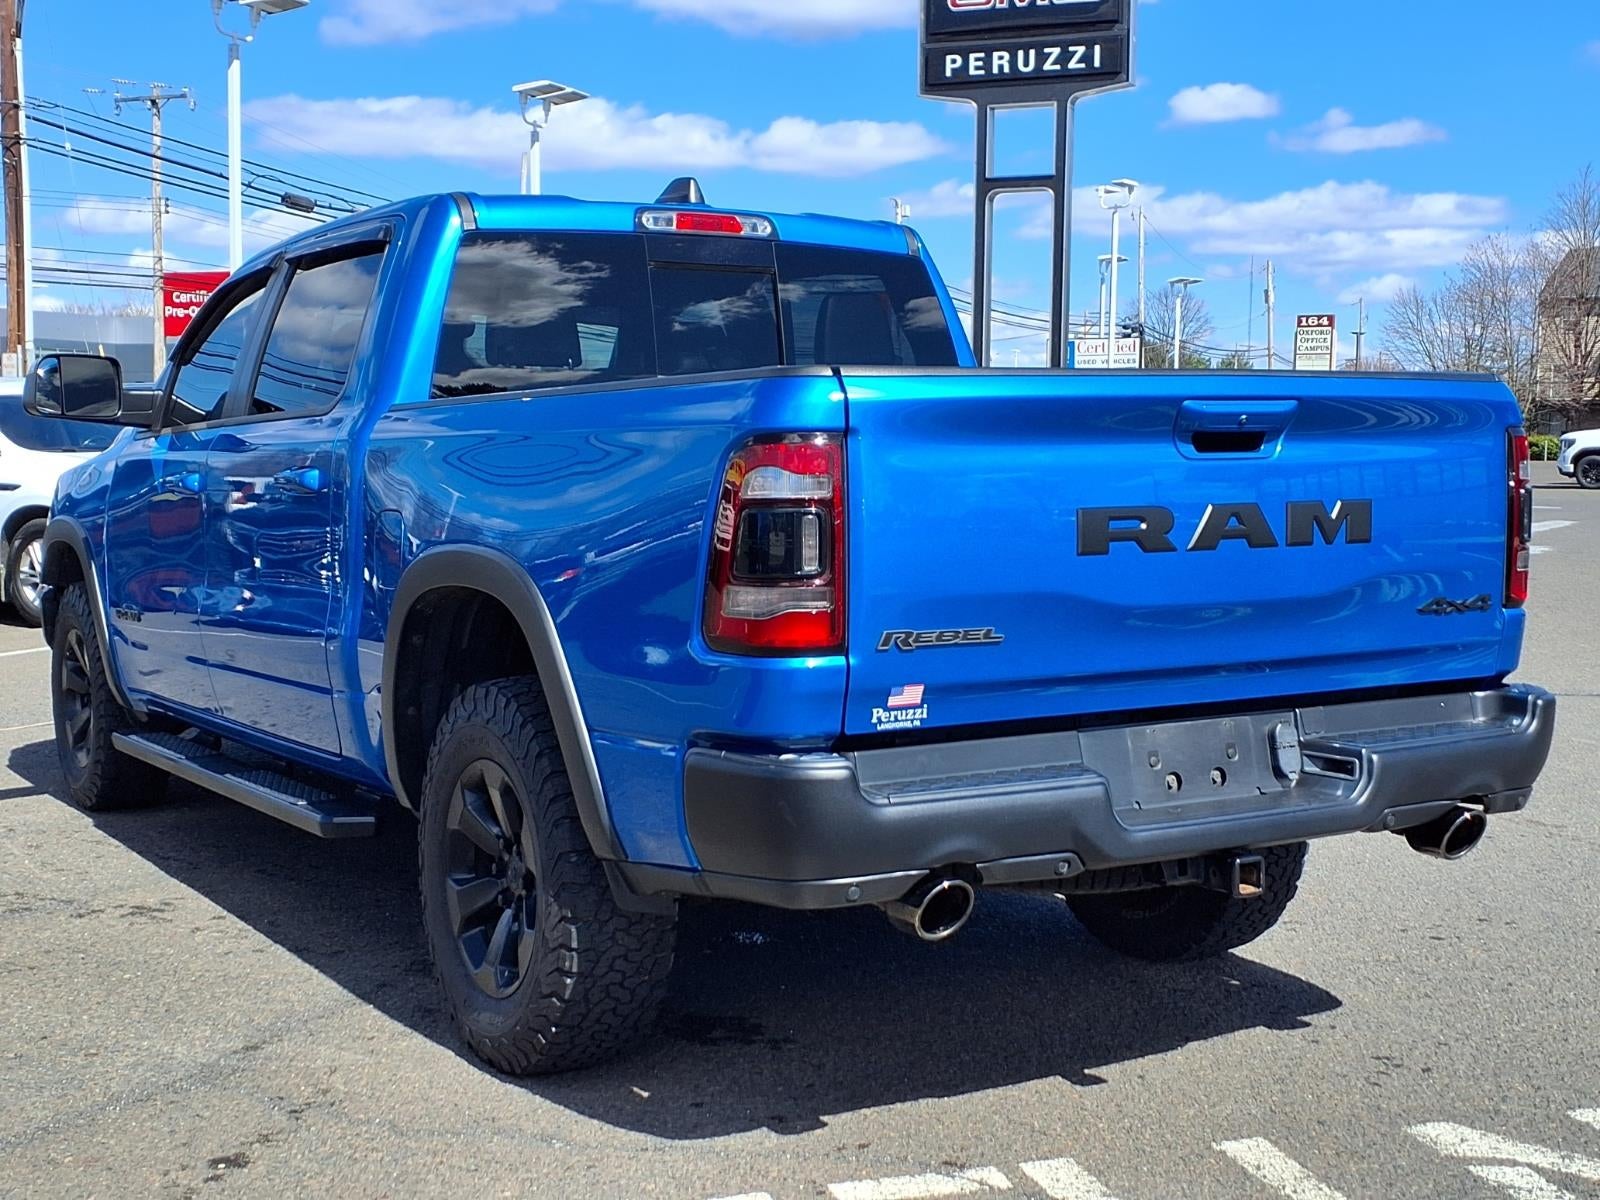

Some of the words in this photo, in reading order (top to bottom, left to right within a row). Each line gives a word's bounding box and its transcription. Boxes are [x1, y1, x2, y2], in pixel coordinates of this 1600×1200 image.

[945, 44, 1101, 77] PERUZZI
[1299, 316, 1330, 326] 164
[1077, 340, 1136, 353] Certied
[1076, 499, 1373, 556] RAM
[877, 627, 1005, 651] REBEL
[871, 703, 928, 723] Peruzzi
